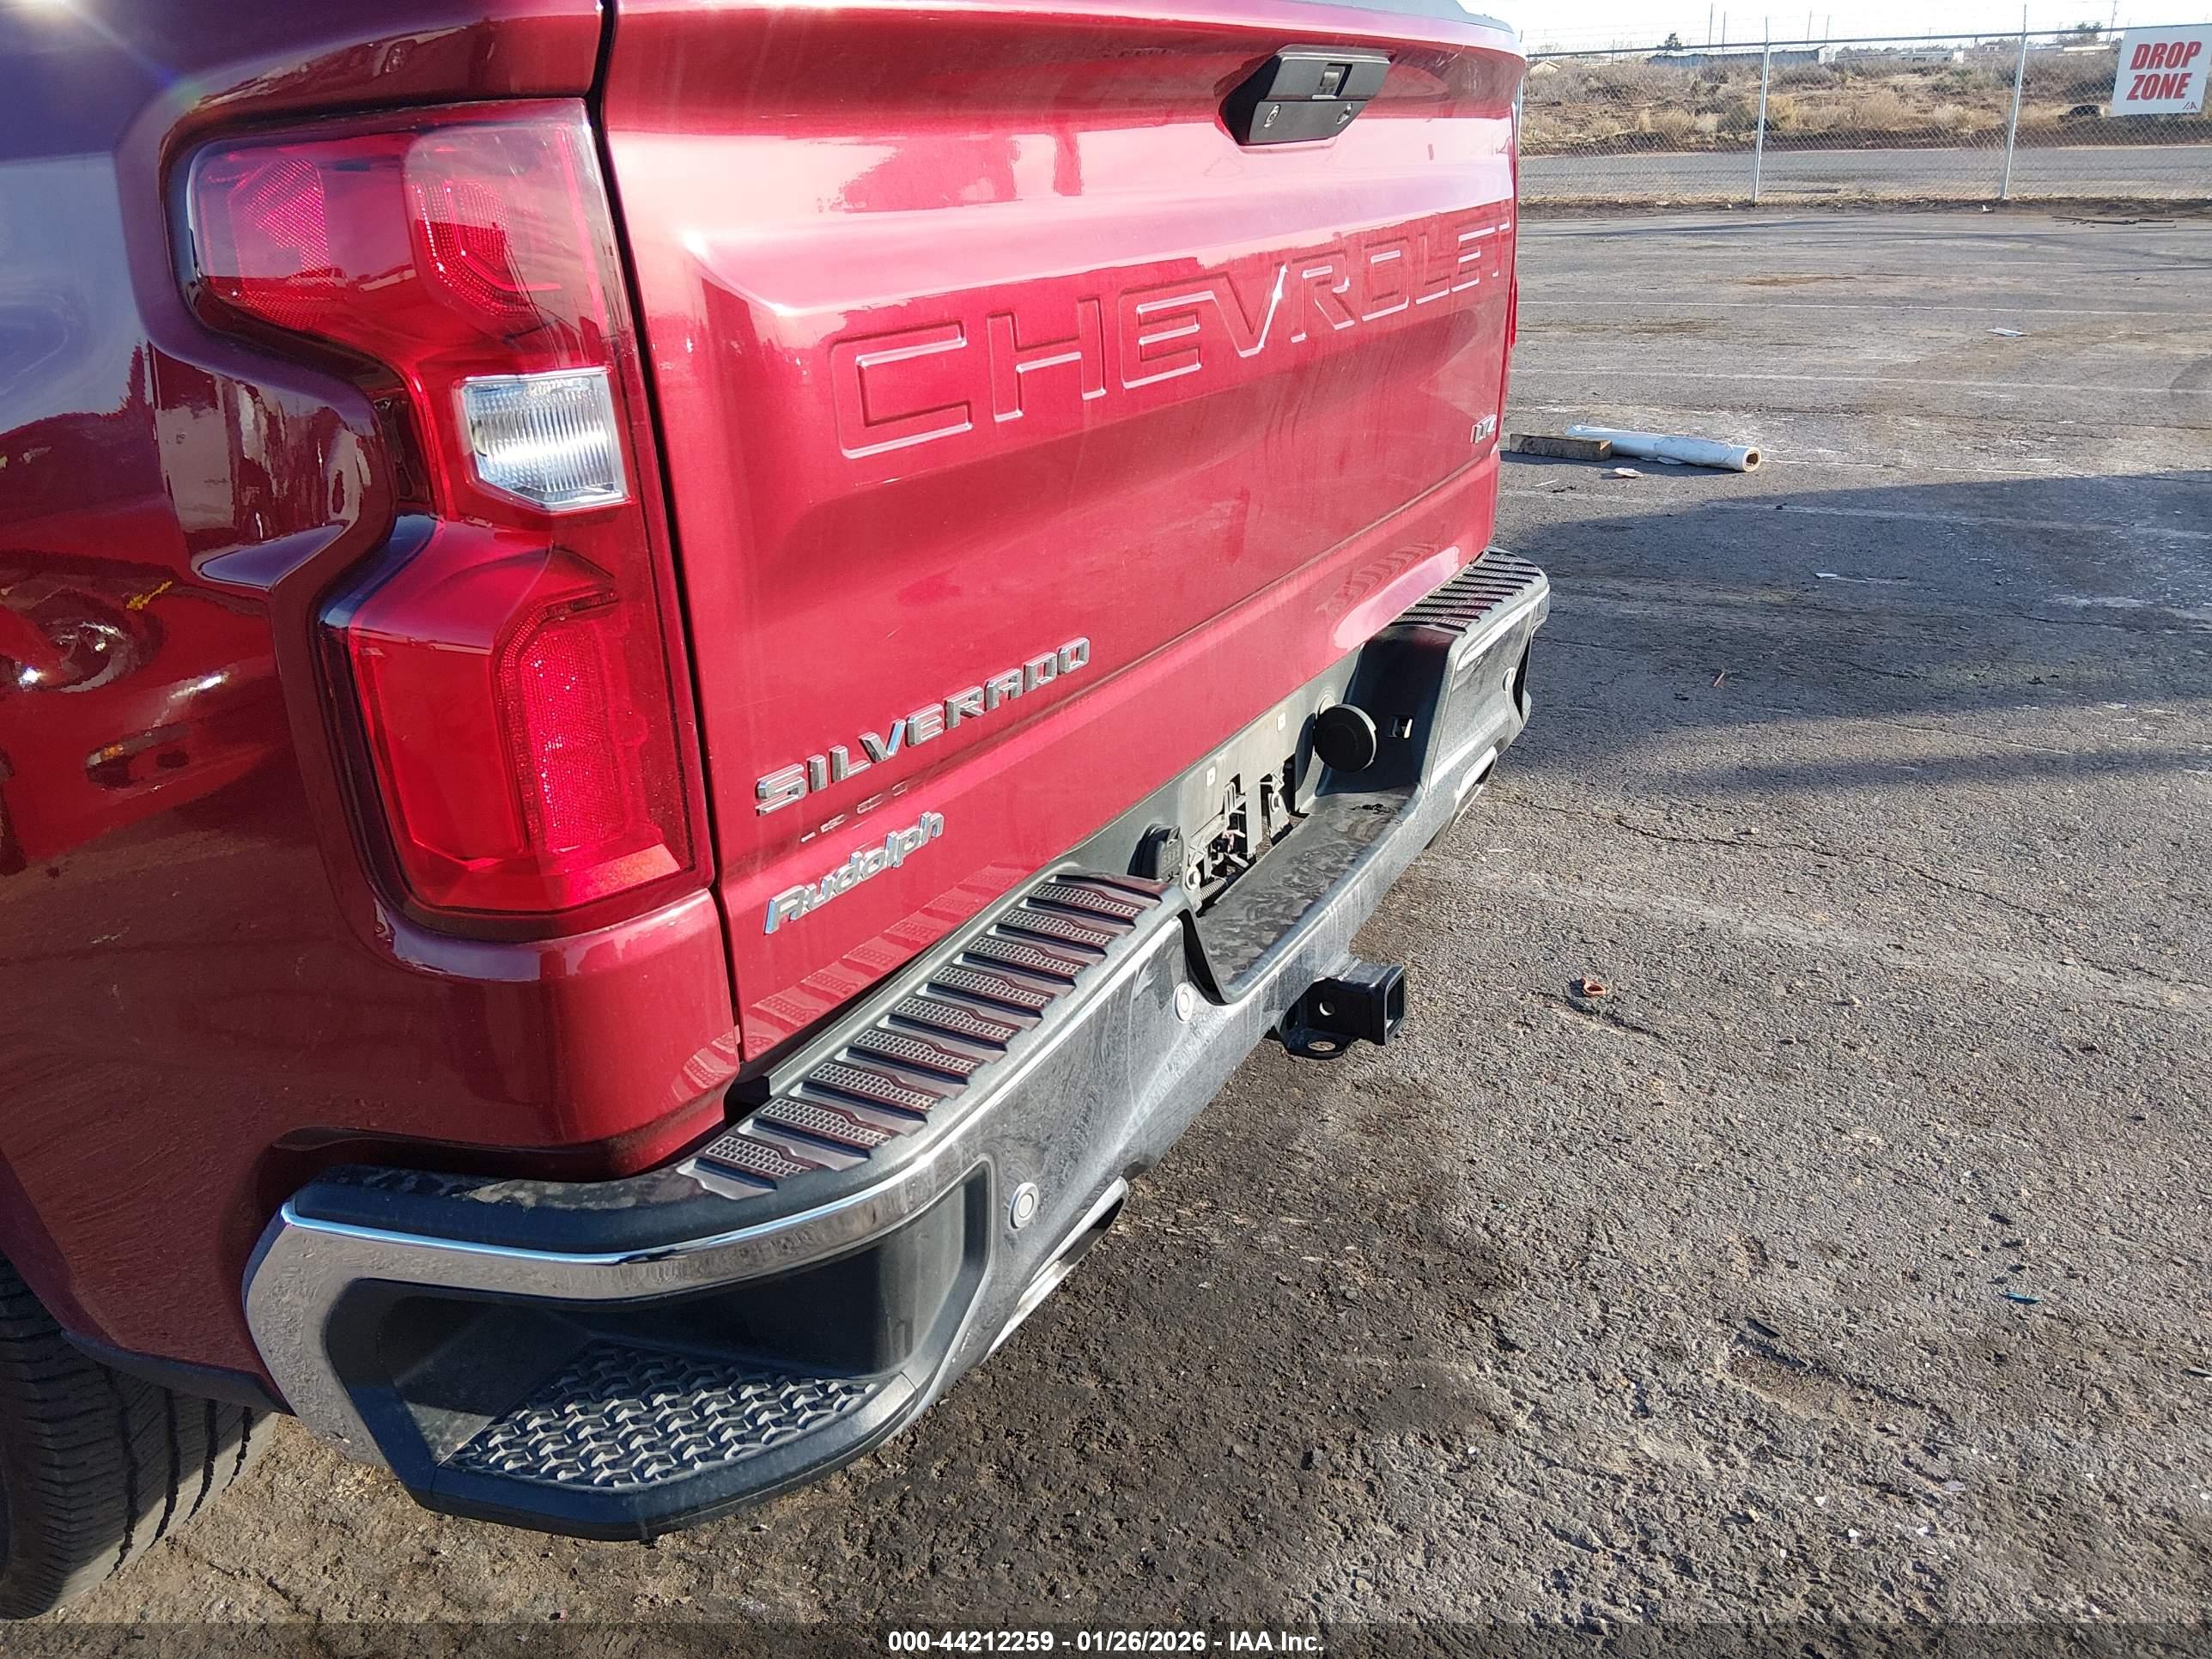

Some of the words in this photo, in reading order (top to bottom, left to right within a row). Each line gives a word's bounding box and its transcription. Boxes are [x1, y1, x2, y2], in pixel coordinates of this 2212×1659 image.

[2126, 72, 2193, 100] ZONE
[2130, 41, 2202, 70] DROP
[830, 213, 1510, 459] CHEVROLET
[756, 636, 1091, 816] SILVERADO
[763, 811, 944, 934] Rudolph
